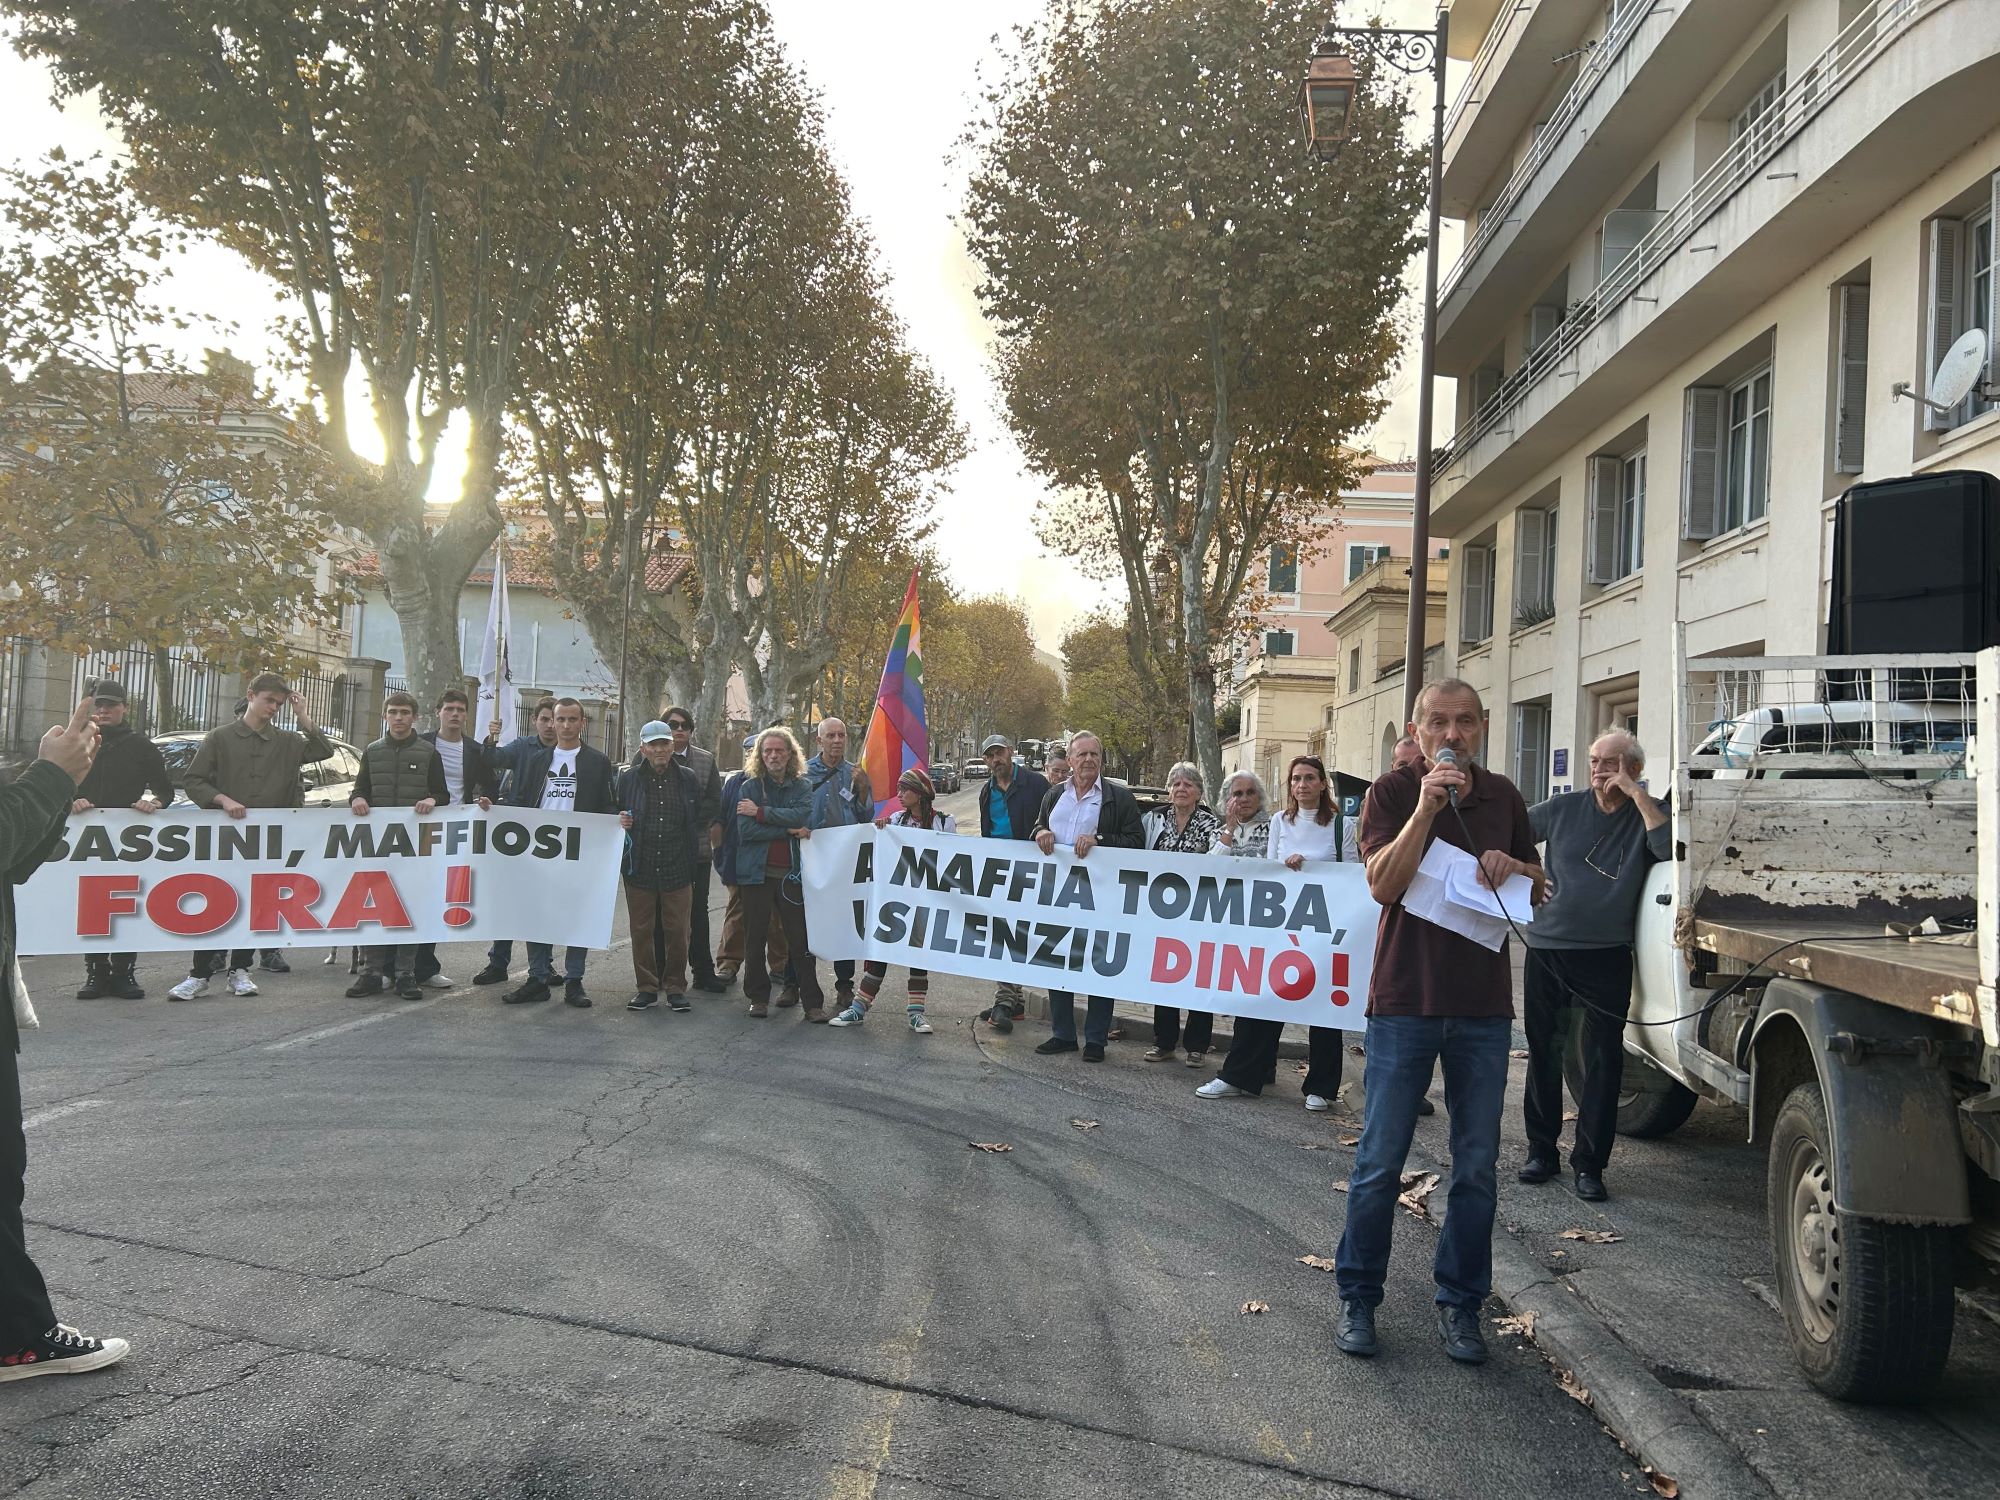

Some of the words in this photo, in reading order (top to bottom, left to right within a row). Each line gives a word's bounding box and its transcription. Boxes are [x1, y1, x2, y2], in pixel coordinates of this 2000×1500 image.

[547, 788, 575, 798] adida
[1344, 797, 1355, 812] P
[324, 820, 581, 860] MAFFIOSI
[76, 870, 412, 936] FORA
[889, 845, 1095, 911] MAFFIA
[1118, 869, 1347, 945] TOMBA,
[872, 900, 1131, 977] SILENZIU
